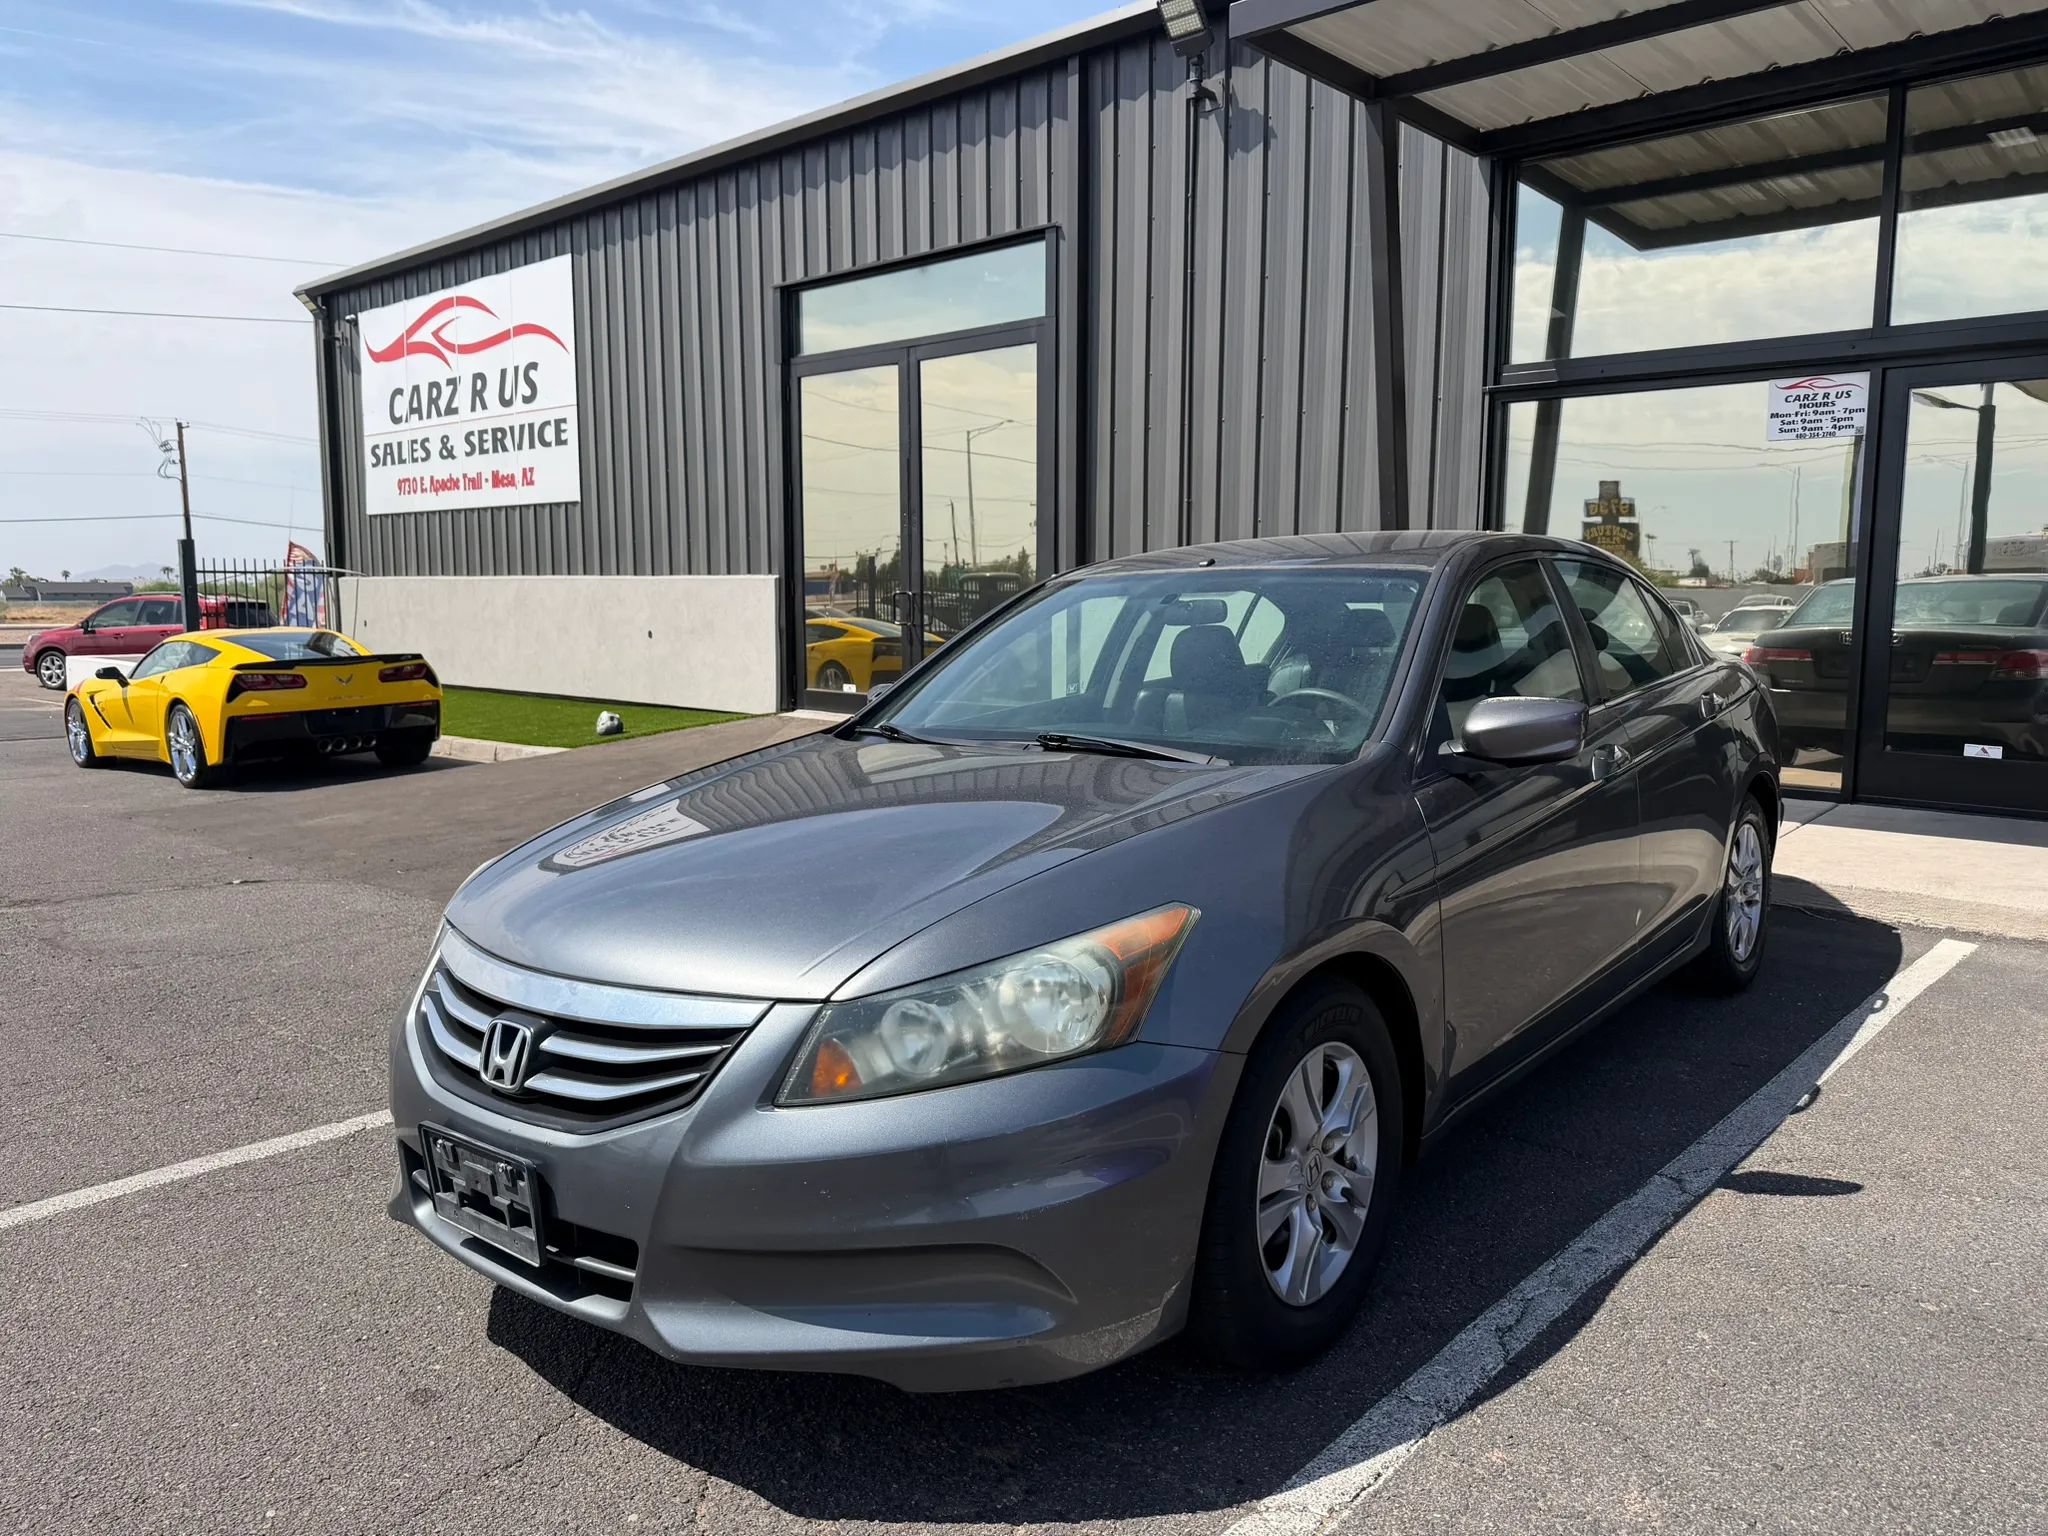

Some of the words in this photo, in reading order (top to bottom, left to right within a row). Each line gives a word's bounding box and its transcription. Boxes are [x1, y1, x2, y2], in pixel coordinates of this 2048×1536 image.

[470, 372, 488, 413] R
[498, 361, 539, 408] US
[1784, 392, 1819, 403] CARZ
[1822, 391, 1830, 400] R
[1835, 390, 1853, 399] US
[1799, 400, 1836, 410] HOURS
[1770, 410, 1811, 419] Mon-Fri:
[1842, 407, 1866, 415] 7pm
[1830, 416, 1854, 424] 5pm
[1778, 426, 1799, 434] Sun:
[1801, 425, 1823, 433] 9am
[1831, 424, 1855, 432] 4pm
[370, 437, 431, 468] SALES
[438, 434, 458, 461] &
[464, 417, 568, 457] SERVICE
[397, 477, 417, 495] 9730
[420, 476, 428, 494] E.
[429, 473, 460, 496] Apache
[462, 472, 482, 491] Trail
[521, 467, 535, 487] AZ
